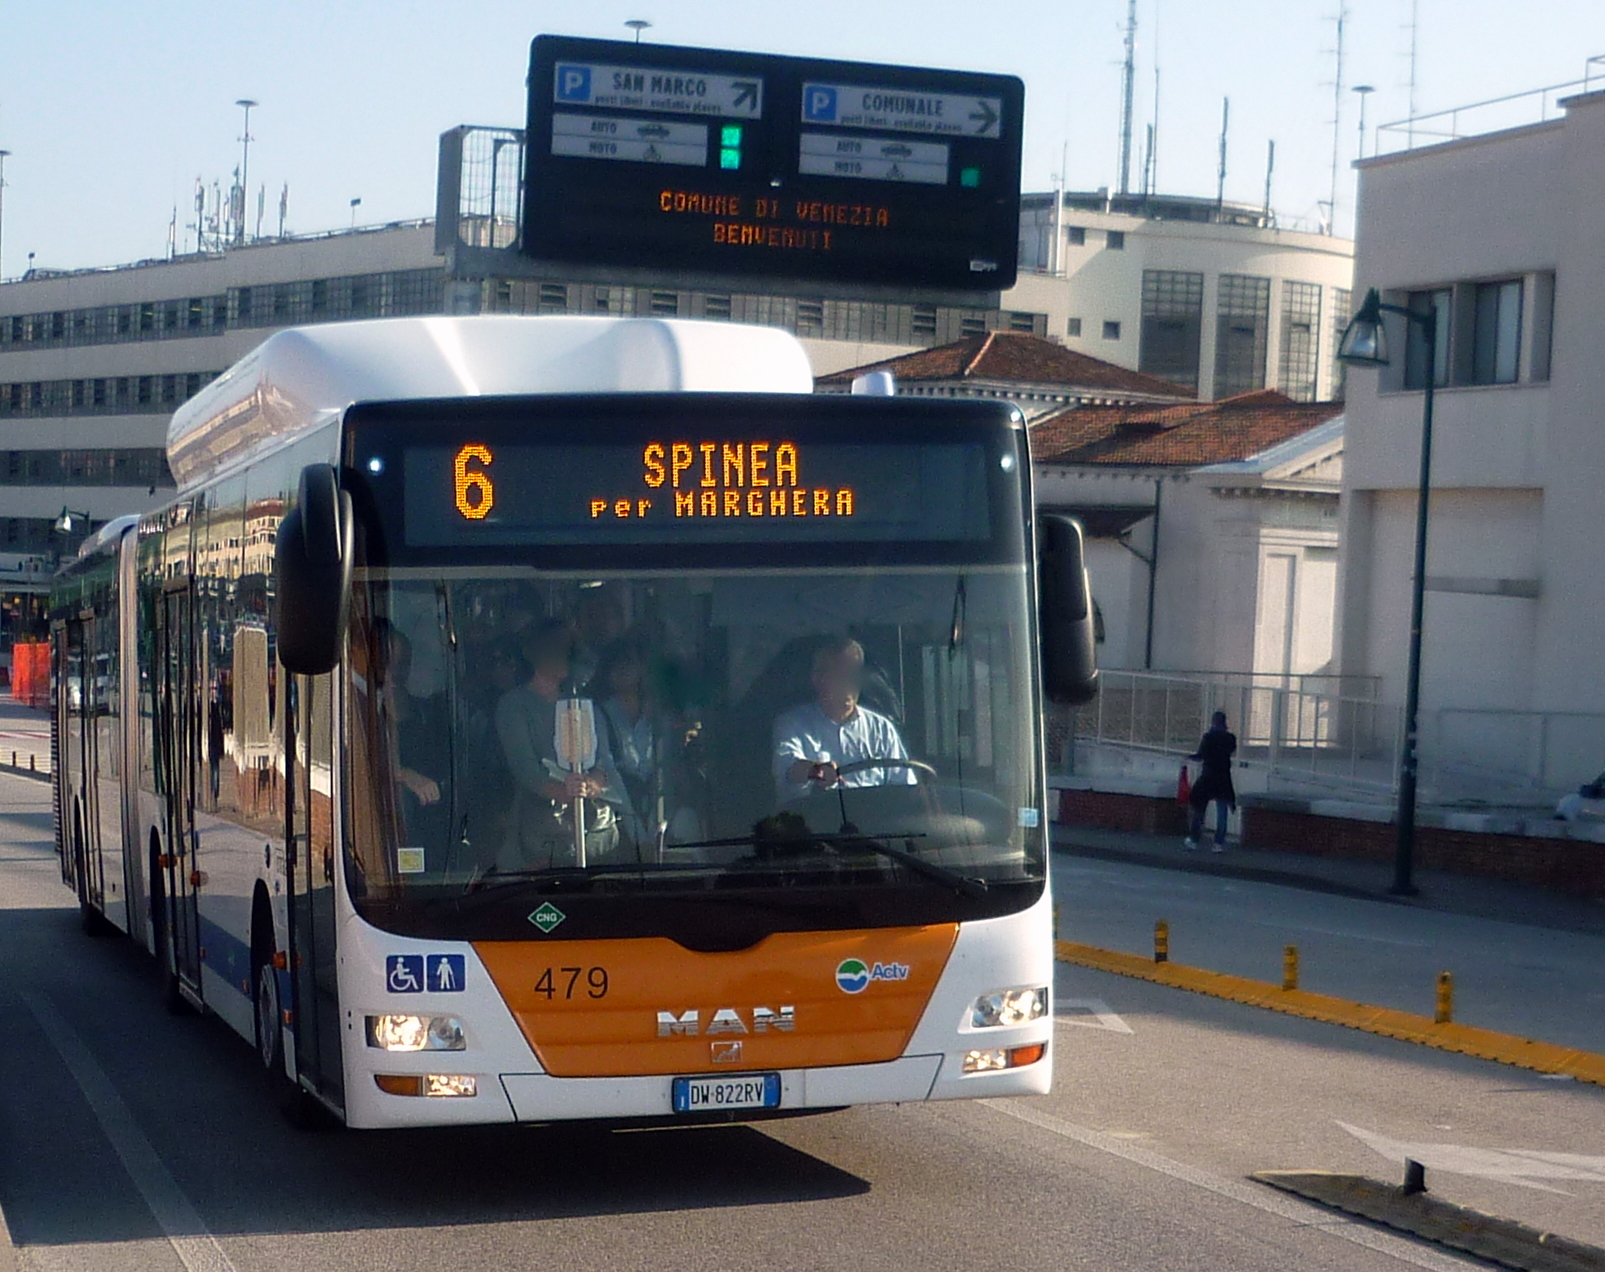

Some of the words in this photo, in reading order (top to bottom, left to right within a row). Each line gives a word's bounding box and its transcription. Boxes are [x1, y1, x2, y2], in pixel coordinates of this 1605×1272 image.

[564, 72, 583, 95] P
[612, 71, 645, 93] SAN
[651, 75, 707, 98] MARCO
[812, 91, 830, 115] P
[862, 93, 944, 117] COMUNALE
[590, 120, 618, 135] AUTO
[588, 141, 618, 156] MOTO
[836, 140, 863, 154] AUTO
[834, 160, 863, 175] MOTO
[659, 189, 741, 217] COMUNE
[755, 199, 779, 219] DI
[796, 200, 890, 227] VENEZIA
[713, 221, 832, 250] BENVENUTI
[643, 442, 798, 488] SPINEA
[454, 443, 494, 520] 6
[590, 499, 652, 519] per
[675, 489, 854, 518] MARGHERA
[536, 912, 558, 923] CNG
[534, 966, 610, 1000] 479
[872, 963, 908, 979] Actv
[656, 1005, 795, 1037] MAN
